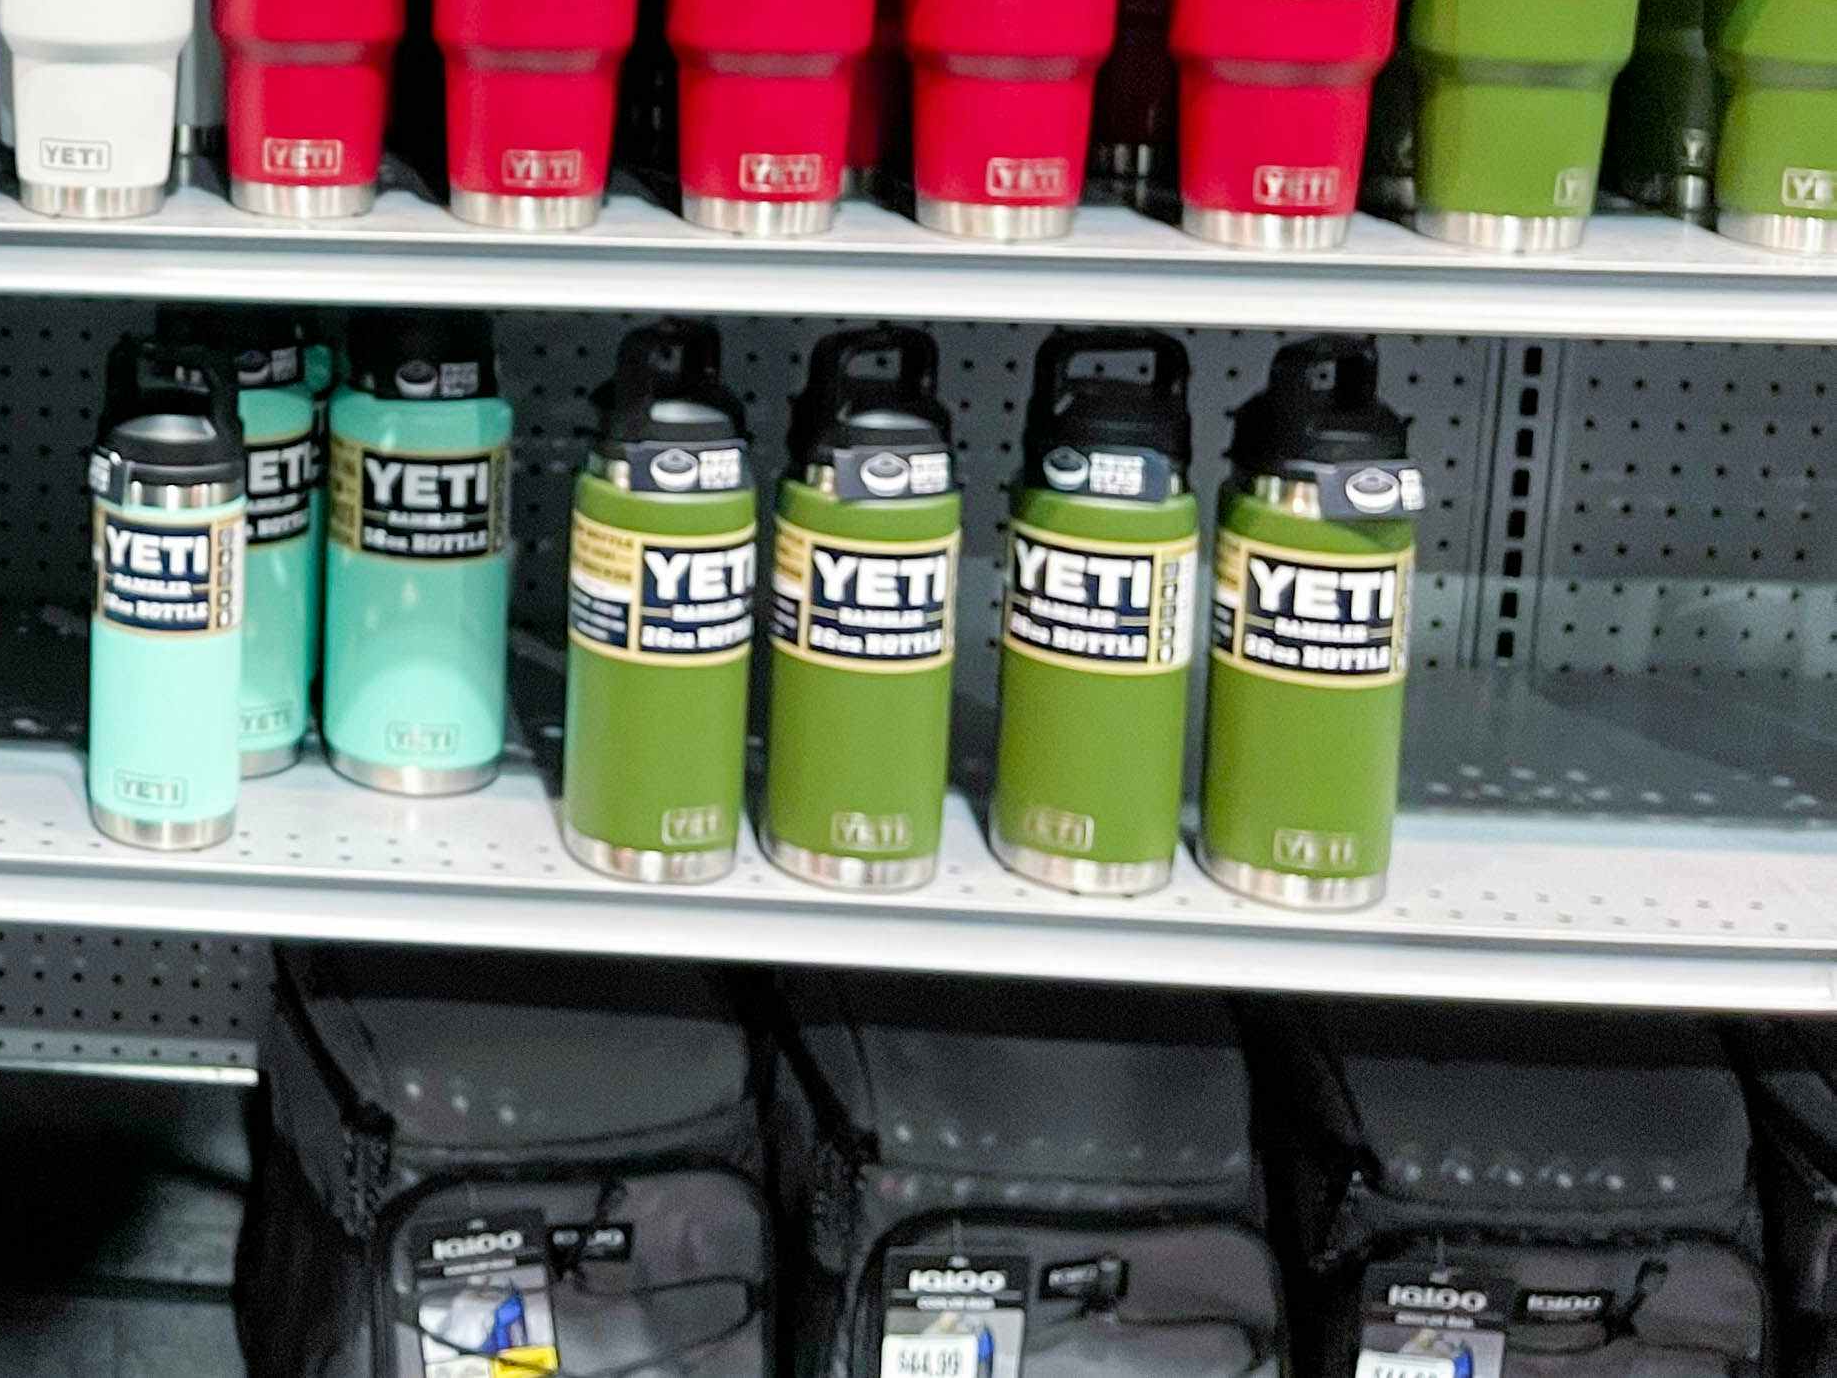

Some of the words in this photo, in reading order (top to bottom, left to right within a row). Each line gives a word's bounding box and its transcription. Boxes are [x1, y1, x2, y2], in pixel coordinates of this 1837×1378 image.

[43, 146, 105, 166] YETI
[271, 145, 335, 170] YETI
[248, 442, 313, 492] ETI
[364, 462, 488, 509] YETI
[104, 526, 209, 575] YETI
[412, 530, 489, 554] BOTTLE
[813, 552, 946, 608] YETI
[1014, 541, 1152, 609] YETI
[1249, 559, 1396, 621] YETI
[668, 811, 722, 839] YET
[908, 1268, 1007, 1294] IGLOO
[1387, 1283, 1488, 1314] IGLOO
